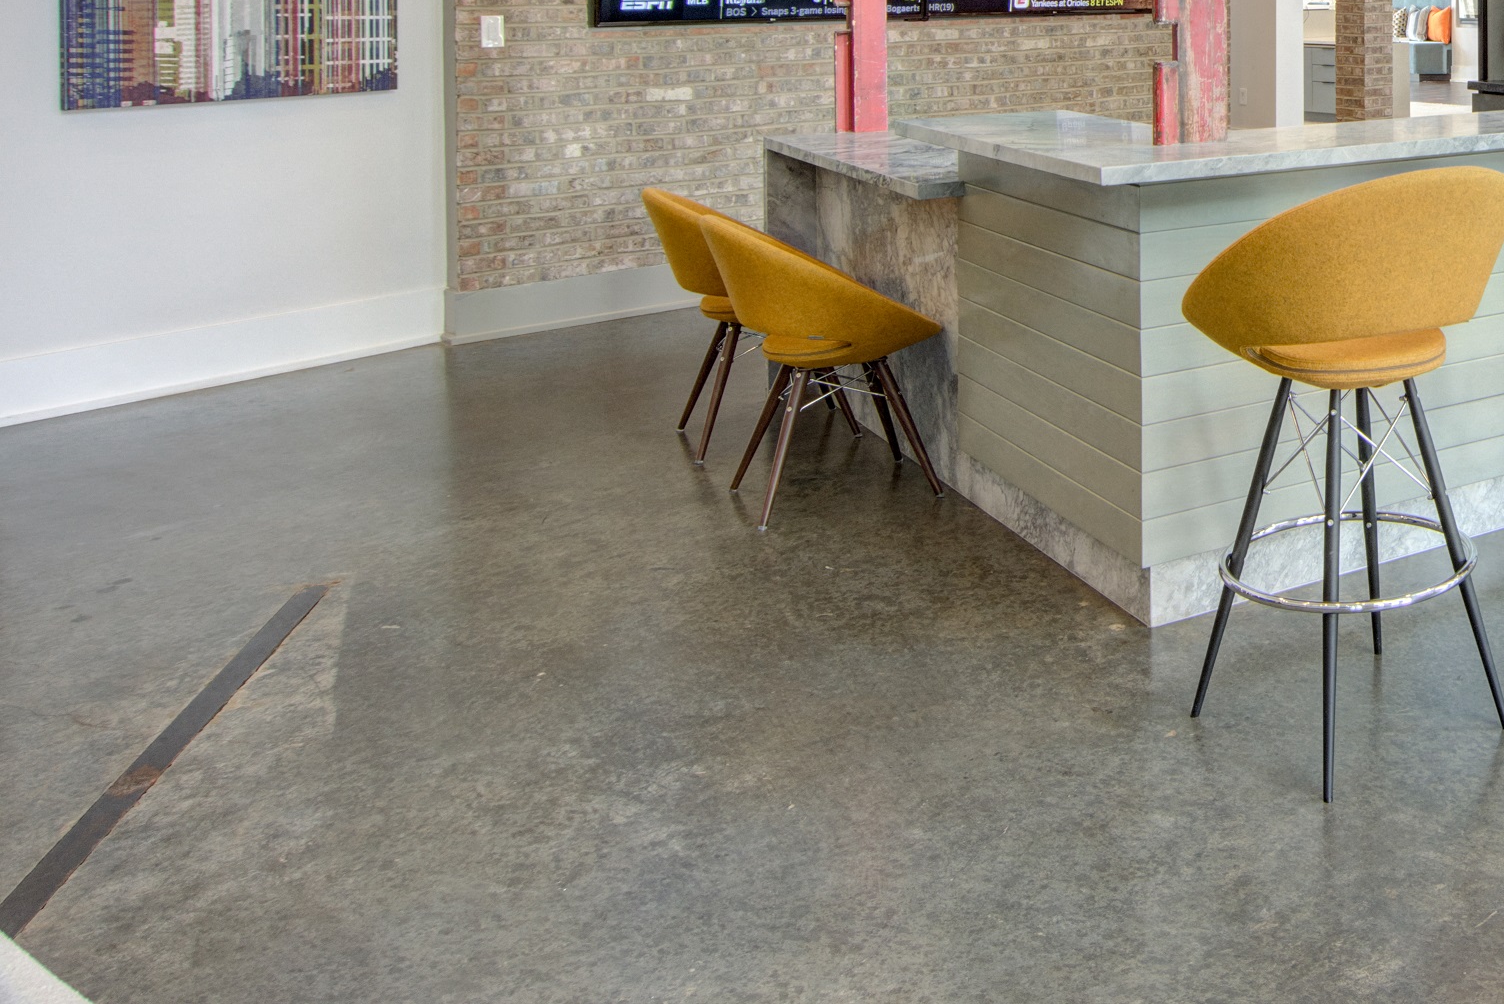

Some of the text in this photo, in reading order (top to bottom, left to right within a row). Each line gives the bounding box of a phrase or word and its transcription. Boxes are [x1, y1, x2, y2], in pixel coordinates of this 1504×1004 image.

[1031, 0, 1058, 8] Yankees
[1090, 0, 1096, 7] 8
[725, 7, 747, 16] BOS
[761, 7, 789, 16] Snaps
[790, 6, 823, 16] 3-game
